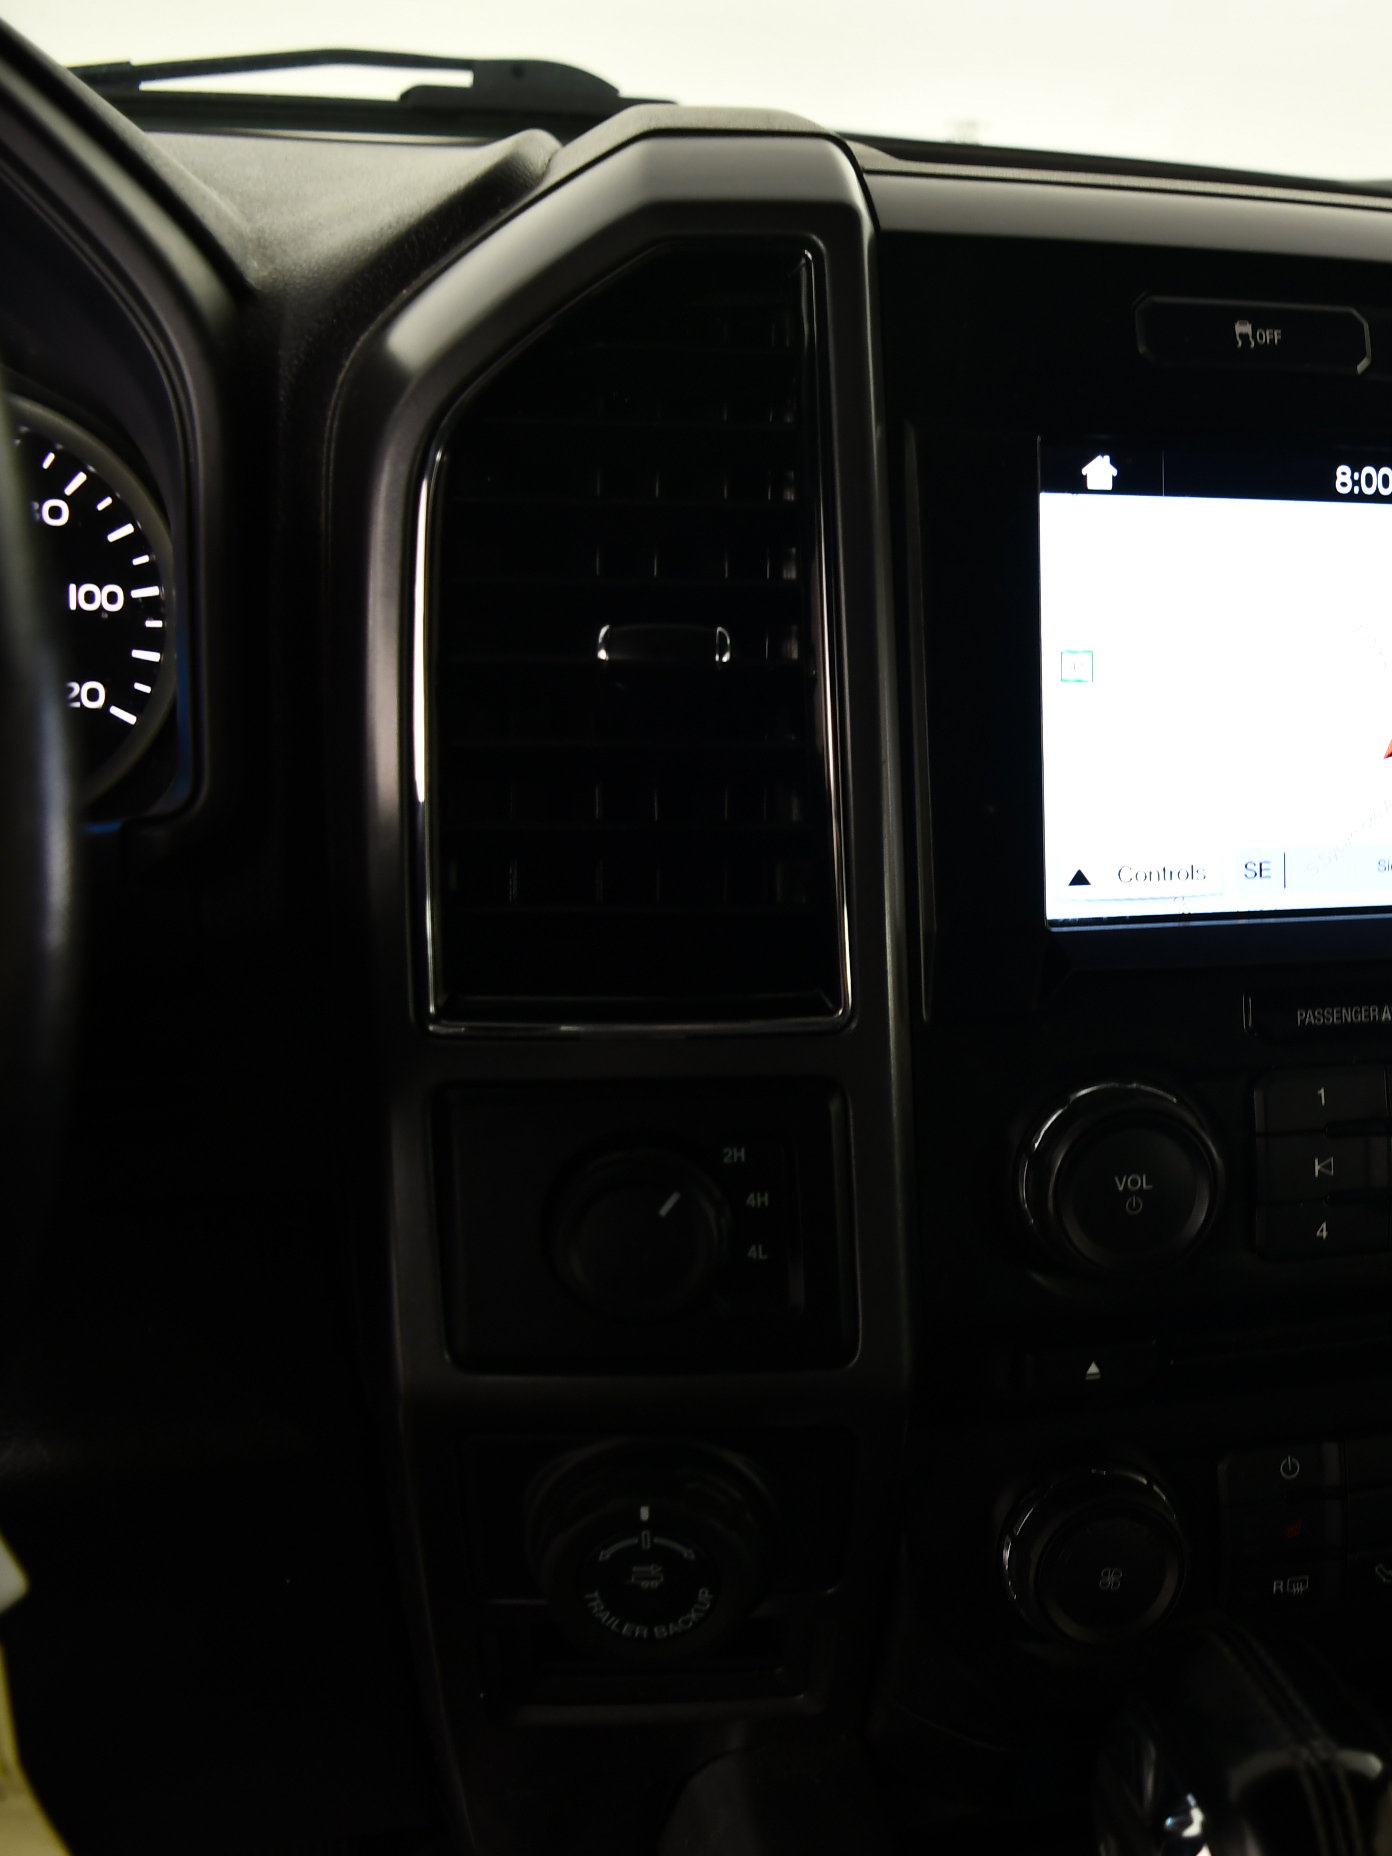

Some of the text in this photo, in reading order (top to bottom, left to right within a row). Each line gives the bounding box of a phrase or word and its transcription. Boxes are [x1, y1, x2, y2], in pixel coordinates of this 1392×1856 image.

[1256, 328, 1282, 346] OFF
[68, 583, 125, 612] 100
[1117, 863, 1207, 885] Controls
[1243, 860, 1272, 881] SE
[1297, 1004, 1379, 1026] PASSENGER
[1316, 1087, 1326, 1106] 1
[722, 1147, 746, 1164] 2H
[1114, 1173, 1153, 1192] VOL
[746, 1191, 769, 1209] 4H
[1315, 1220, 1328, 1241] 4
[747, 1244, 768, 1261] 4L
[584, 1586, 713, 1639] TRAILER BACKUP
